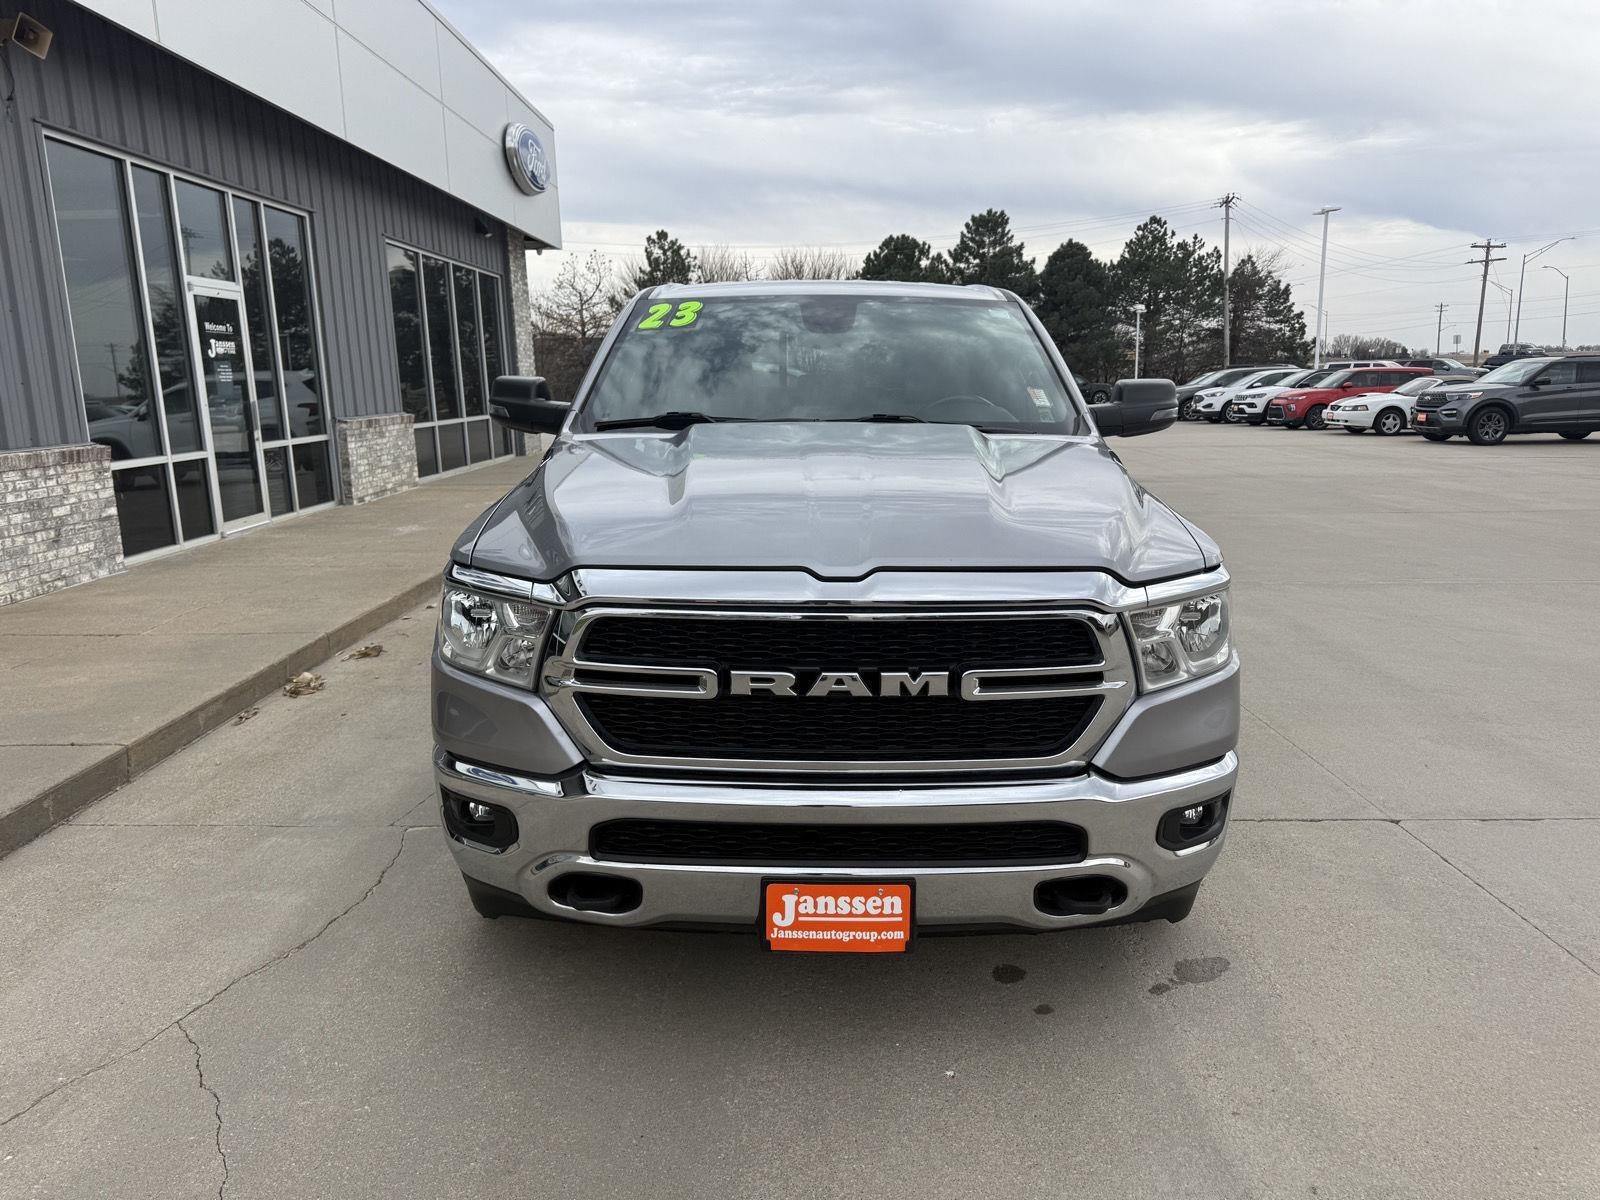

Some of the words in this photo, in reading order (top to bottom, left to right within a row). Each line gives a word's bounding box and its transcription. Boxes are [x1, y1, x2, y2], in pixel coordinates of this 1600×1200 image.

[638, 301, 703, 329] 23
[730, 671, 949, 697] RAM
[772, 894, 903, 927] Janssen
[771, 928, 904, 942] Janssenautogroup.com
